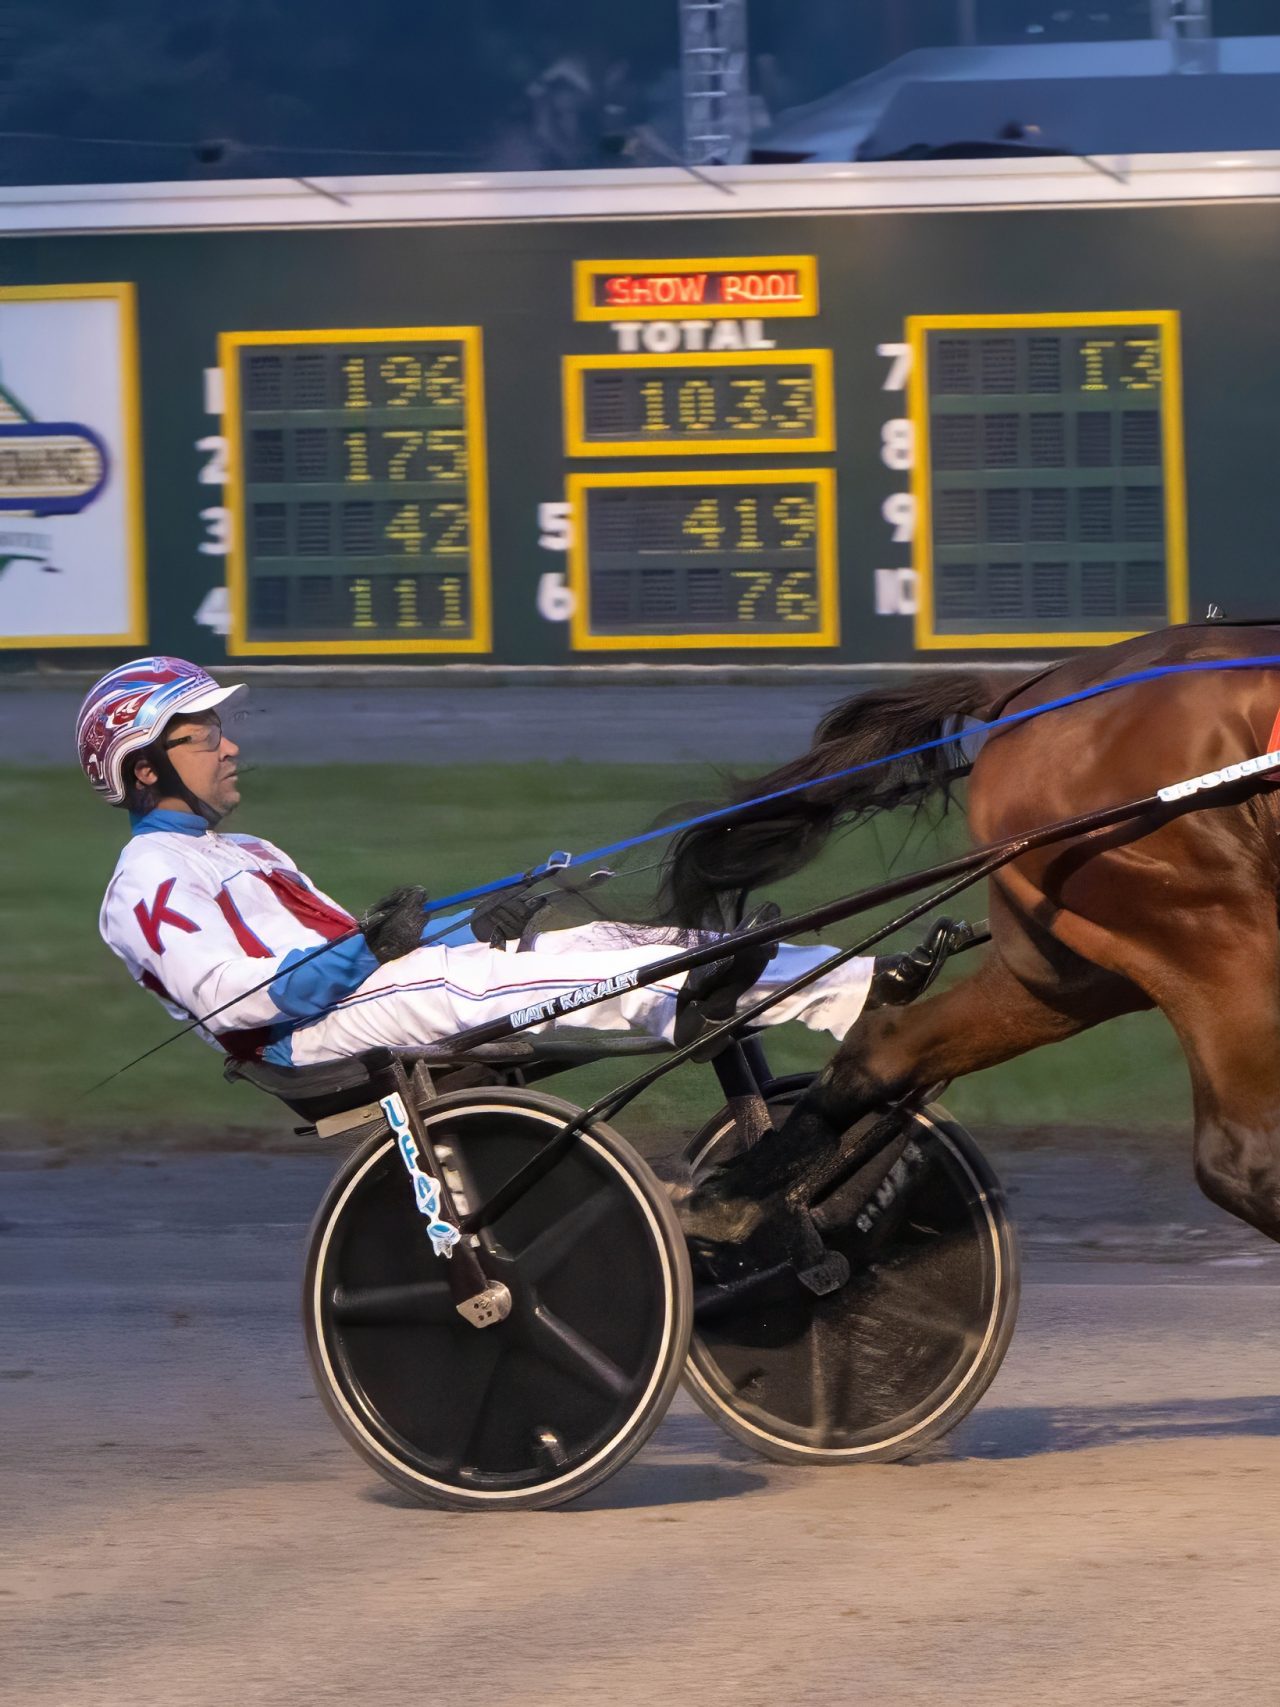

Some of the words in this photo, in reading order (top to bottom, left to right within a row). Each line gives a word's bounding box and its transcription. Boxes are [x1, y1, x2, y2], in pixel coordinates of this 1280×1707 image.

[605, 274, 706, 303] SHOW
[610, 319, 777, 352] TOTAL
[342, 355, 465, 408] 196
[876, 343, 914, 391] 7
[1080, 340, 1163, 390] 13
[203, 367, 226, 414] 1
[639, 379, 812, 430] 1033
[194, 436, 230, 484] 2
[343, 430, 467, 482] 175
[880, 418, 915, 470] 8
[198, 506, 232, 555] 3
[384, 504, 471, 553] 42
[537, 502, 573, 550] 5
[682, 497, 816, 548] 419
[881, 492, 917, 542] 9
[194, 587, 234, 635] 4
[350, 577, 466, 628] 111
[537, 571, 577, 622] 6
[730, 571, 819, 622] 76
[874, 567, 919, 615] 10
[133, 876, 202, 956] K
[510, 998, 557, 1029] MATT
[559, 970, 640, 1011] KAKALEY
